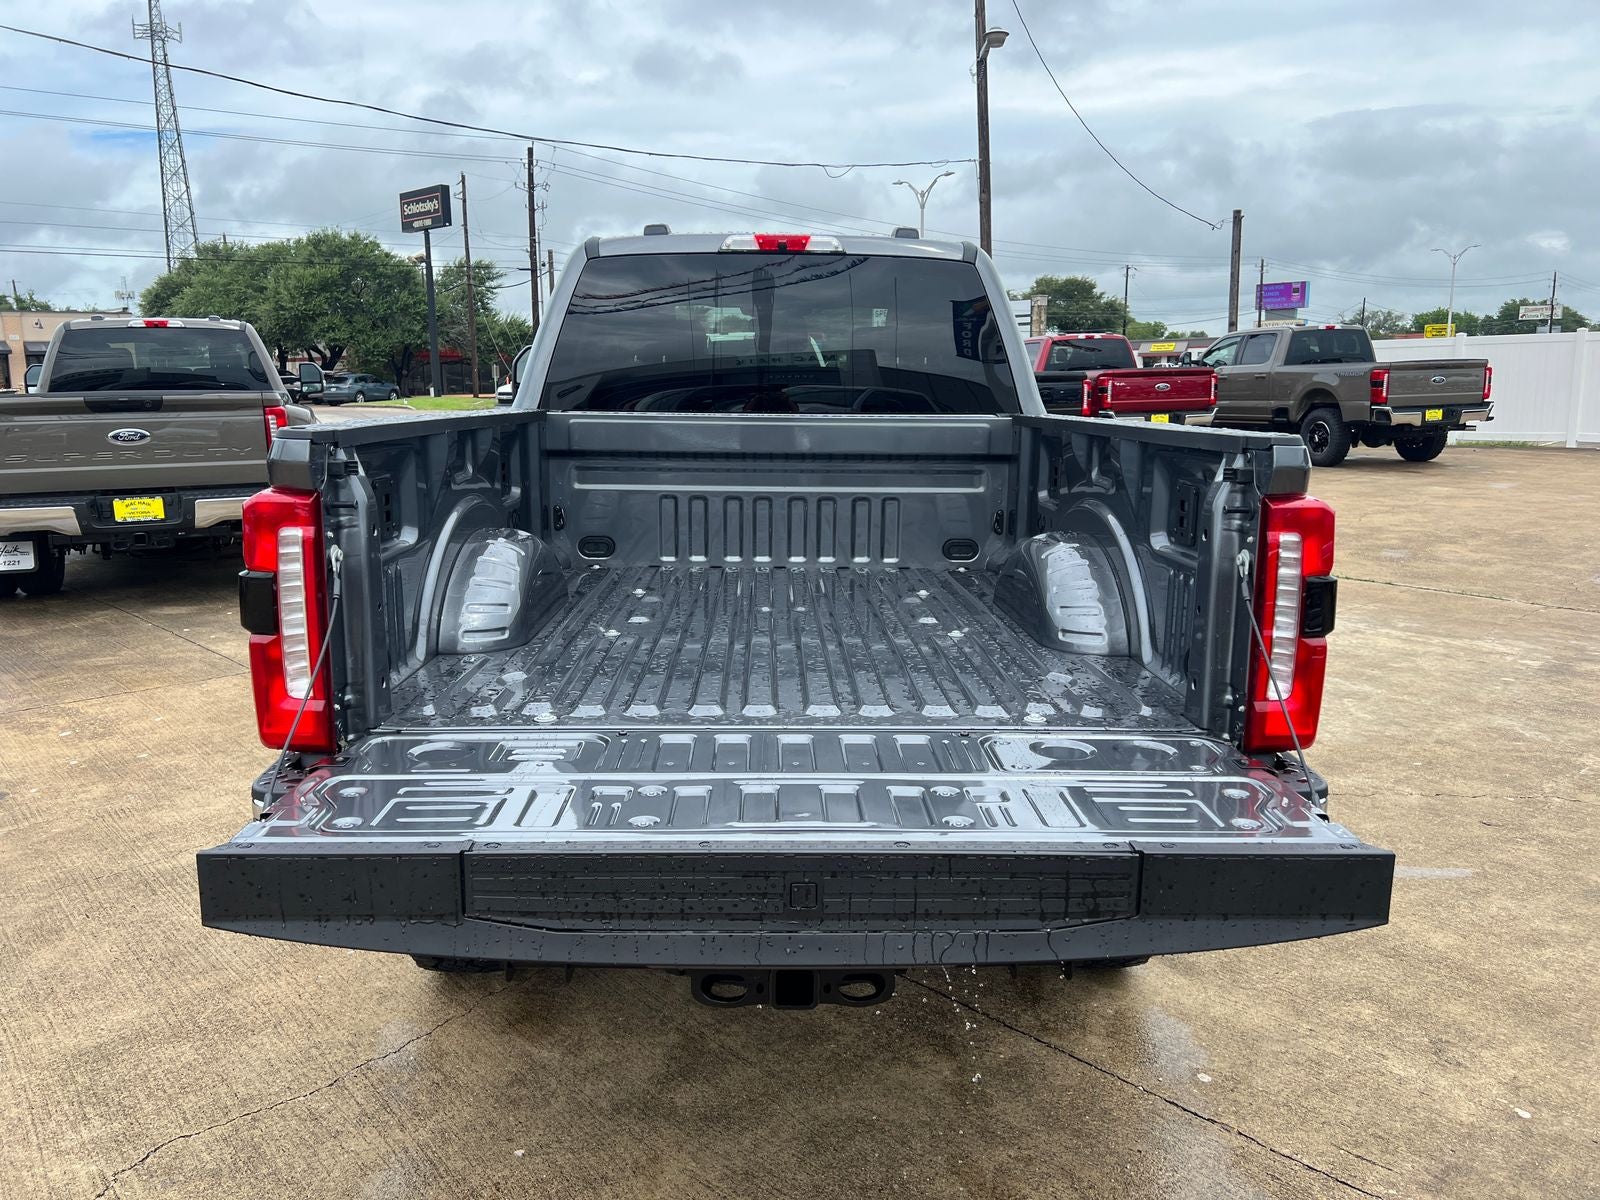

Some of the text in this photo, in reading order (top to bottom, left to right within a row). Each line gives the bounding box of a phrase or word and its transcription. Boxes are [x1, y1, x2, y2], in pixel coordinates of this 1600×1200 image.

[403, 199, 439, 215] Schlotzsky's
[117, 431, 141, 441] Ford
[153, 447, 253, 458] DUTY
